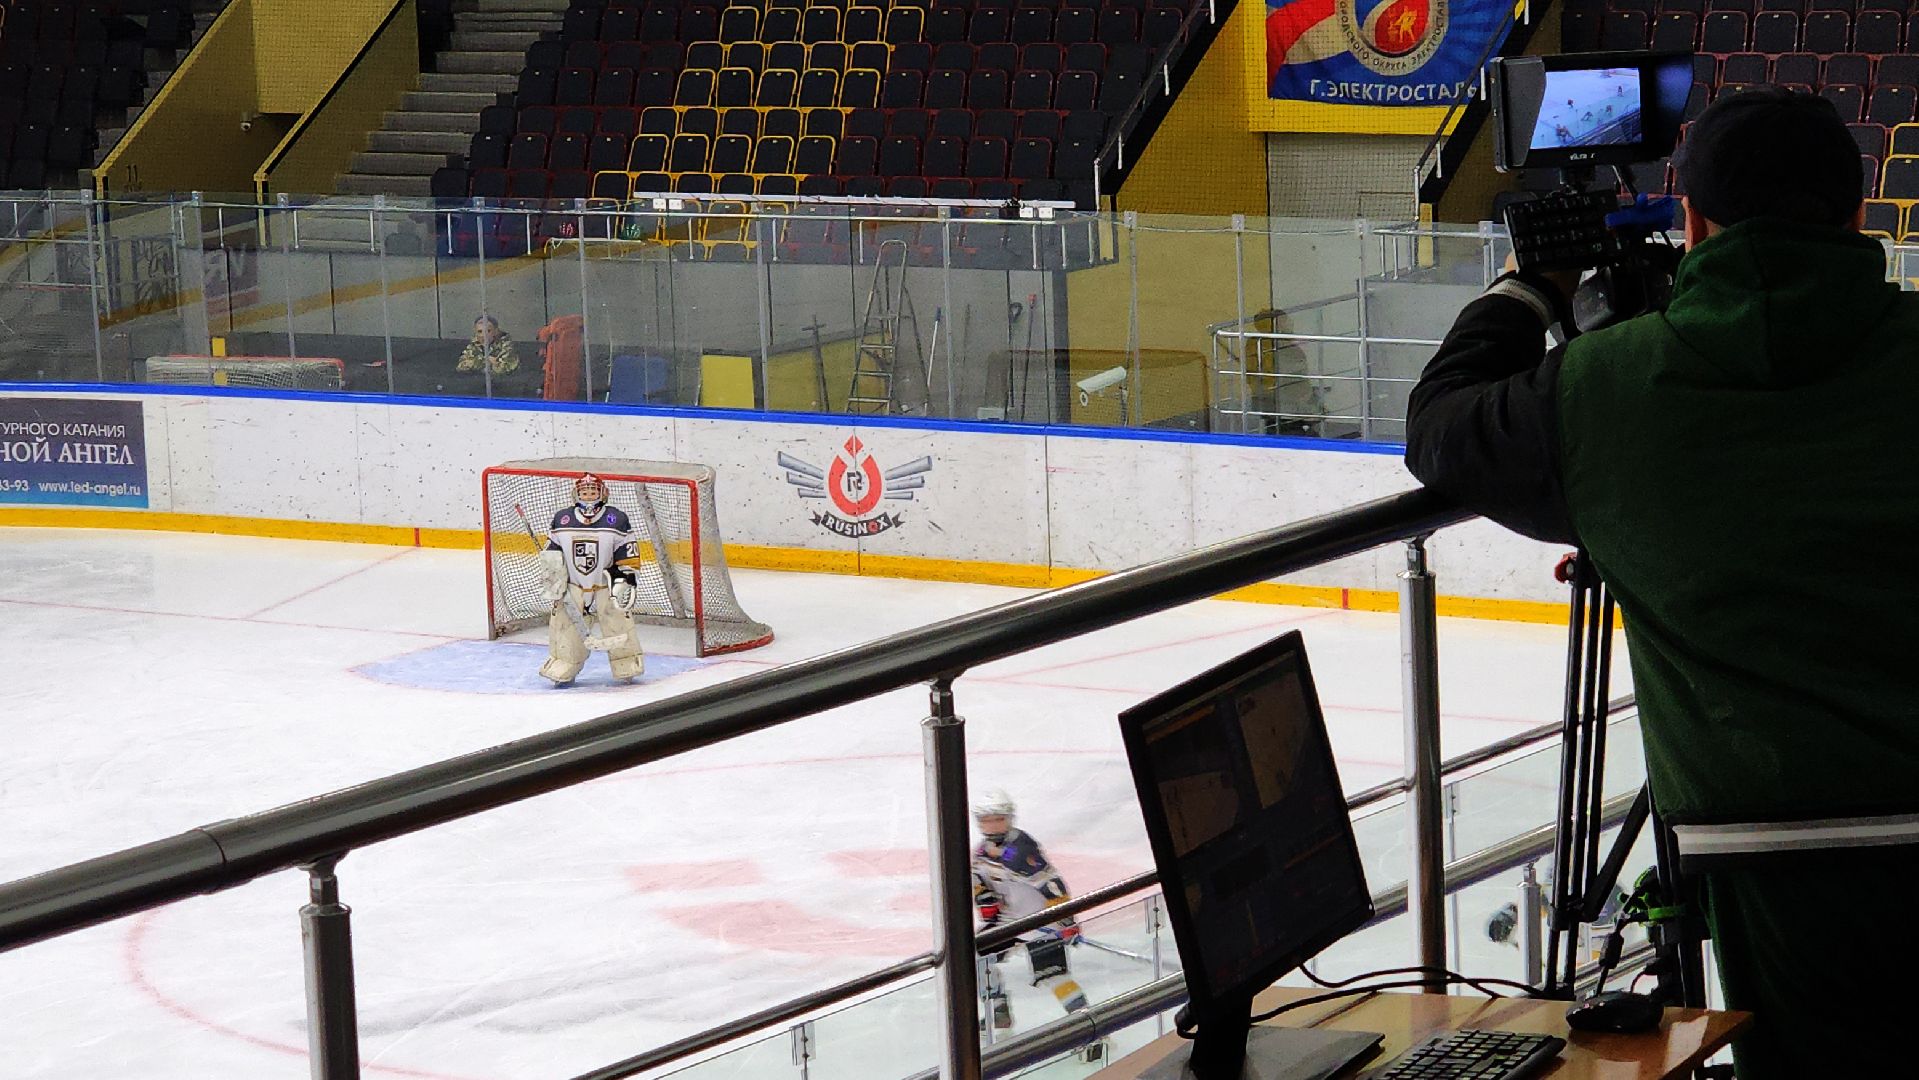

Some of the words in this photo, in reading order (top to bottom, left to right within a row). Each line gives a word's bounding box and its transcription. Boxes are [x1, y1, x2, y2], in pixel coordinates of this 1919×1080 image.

[0, 422, 60, 436] УРНОГО
[64, 423, 126, 438] КАТАНИЯ
[58, 442, 135, 465] АНГЕЛ
[38, 481, 141, 496] www.led-angel.ru
[826, 516, 889, 536] RUSINOX
